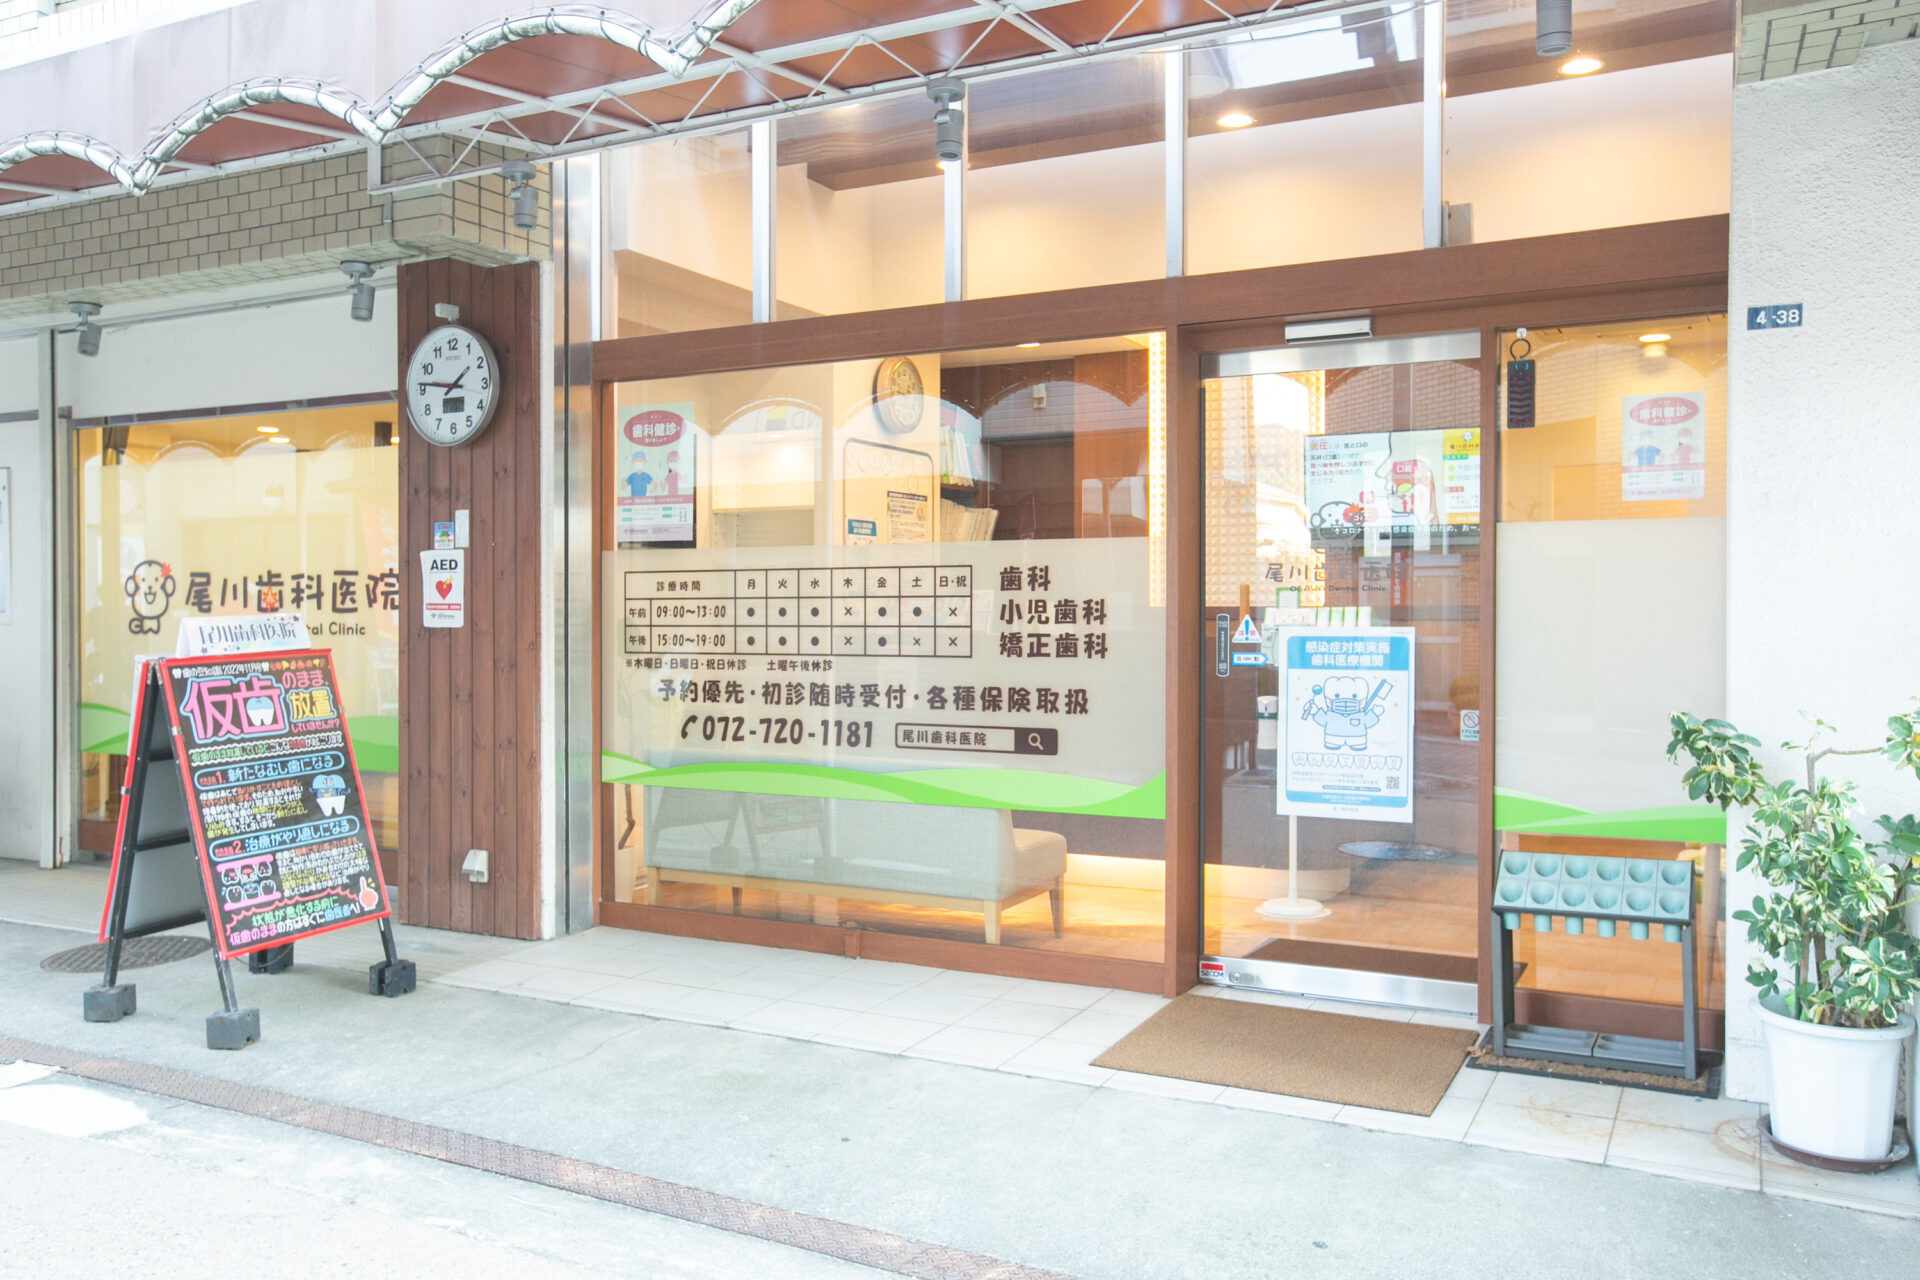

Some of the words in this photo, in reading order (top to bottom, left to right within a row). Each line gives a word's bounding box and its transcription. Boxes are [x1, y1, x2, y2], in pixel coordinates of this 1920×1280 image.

[1756, 309, 1799, 325] 4-38
[447, 338, 458, 351] 12
[466, 342, 471, 355] 1
[433, 345, 442, 359] 11
[422, 362, 433, 375] 10
[477, 356, 484, 369] 2
[419, 384, 426, 396] 9
[481, 377, 488, 390] 3
[424, 403, 431, 416] 8
[477, 398, 484, 411] 4
[435, 418, 442, 431] 7
[466, 415, 473, 428] 5
[450, 423, 457, 435] 6
[430, 559, 458, 571] AED
[747, 579, 756, 590] 月
[778, 578, 788, 589] 火
[810, 578, 820, 589] 水
[843, 577, 853, 588] 木
[877, 576, 887, 588] 金
[912, 576, 922, 588] 土
[1000, 566, 1051, 591] 歯科
[185, 567, 399, 613] 尾川歯科医院
[656, 581, 701, 591] 診療時間
[1362, 584, 1387, 592] Clinic
[629, 608, 646, 618] 午前
[1000, 599, 1106, 625] 小児歯科
[329, 621, 365, 635] Clinic
[629, 635, 646, 646] 午後
[1000, 632, 1108, 659] 矯正歯科
[1305, 641, 1390, 654] 感染症対策実施
[766, 658, 833, 672] 土曜午後休診
[1311, 654, 1384, 667] 歯科医療機関
[289, 689, 334, 720] 放置
[702, 715, 873, 748] 072-720-1181
[902, 729, 987, 746] 尾川歯科医院
[245, 820, 350, 852] 治療がやり直しになる
[251, 896, 339, 928] 状態が悪化する前に
